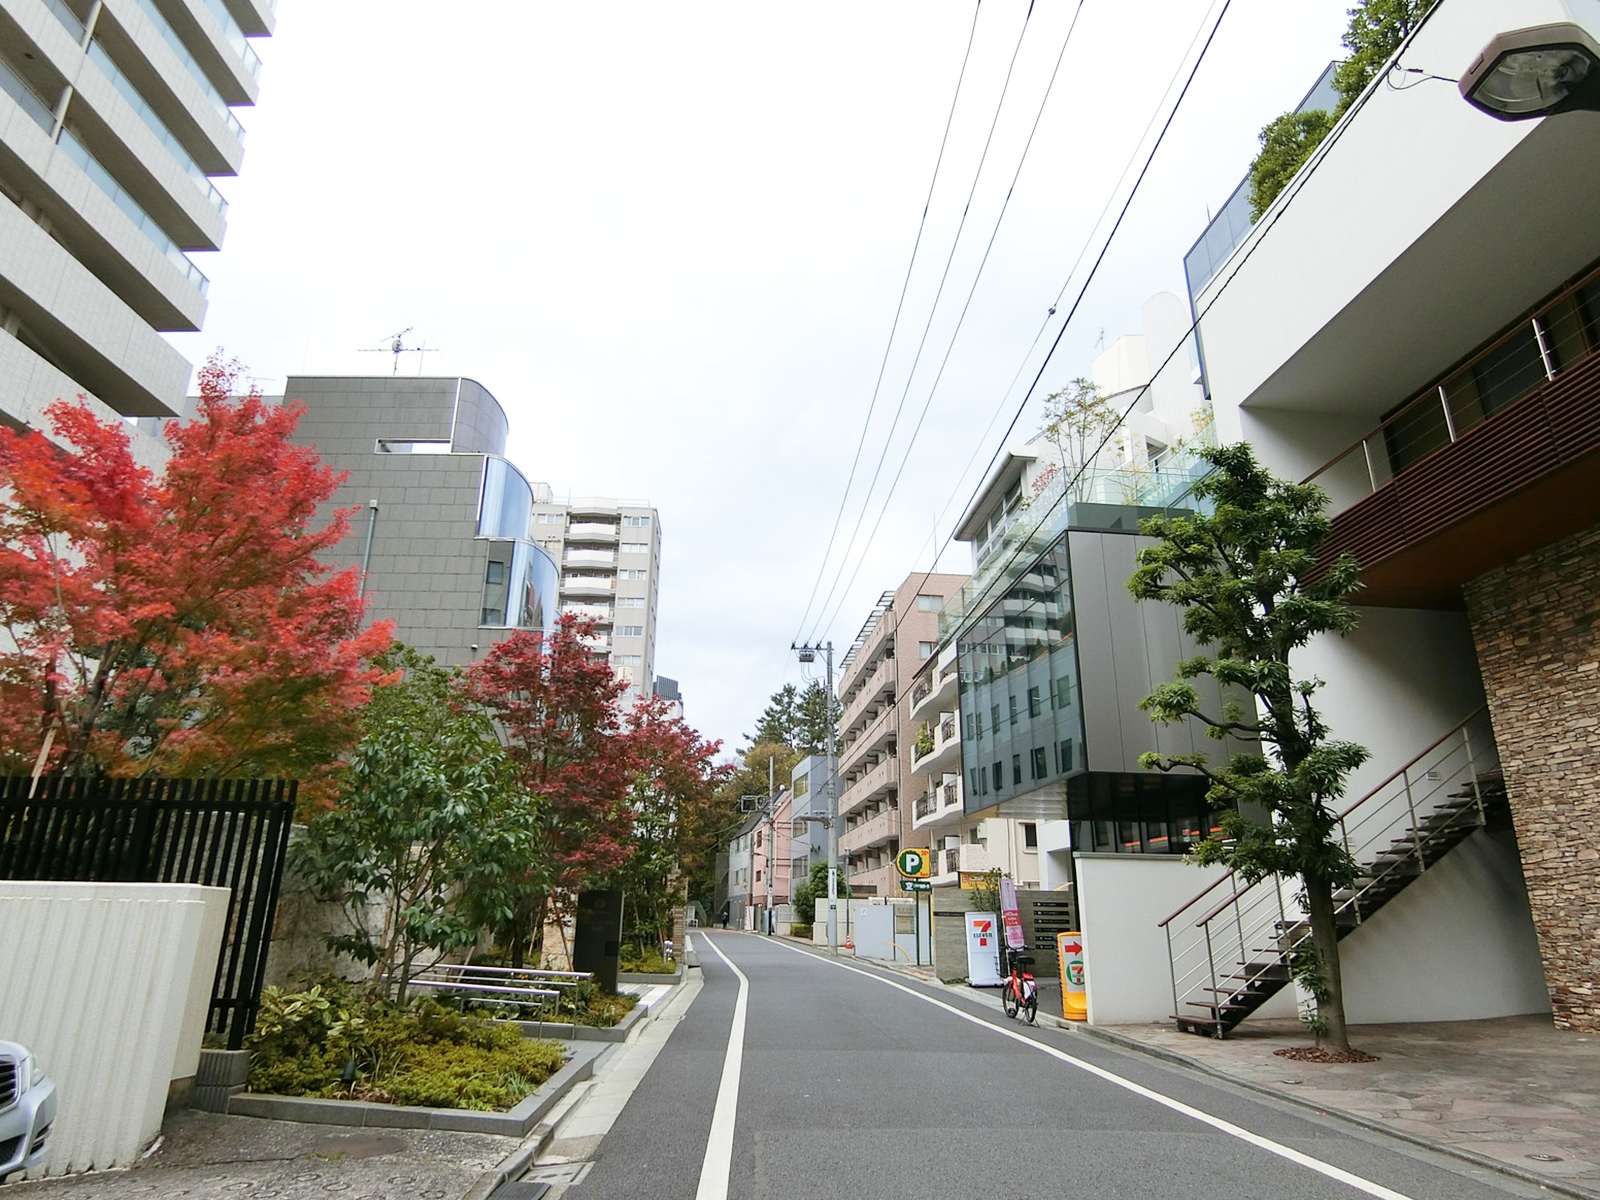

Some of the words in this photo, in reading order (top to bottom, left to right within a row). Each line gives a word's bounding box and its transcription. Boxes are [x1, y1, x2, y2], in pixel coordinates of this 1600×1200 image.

[906, 854, 920, 872] P
[973, 921, 991, 946] 7
[1071, 966, 1083, 983] 7
